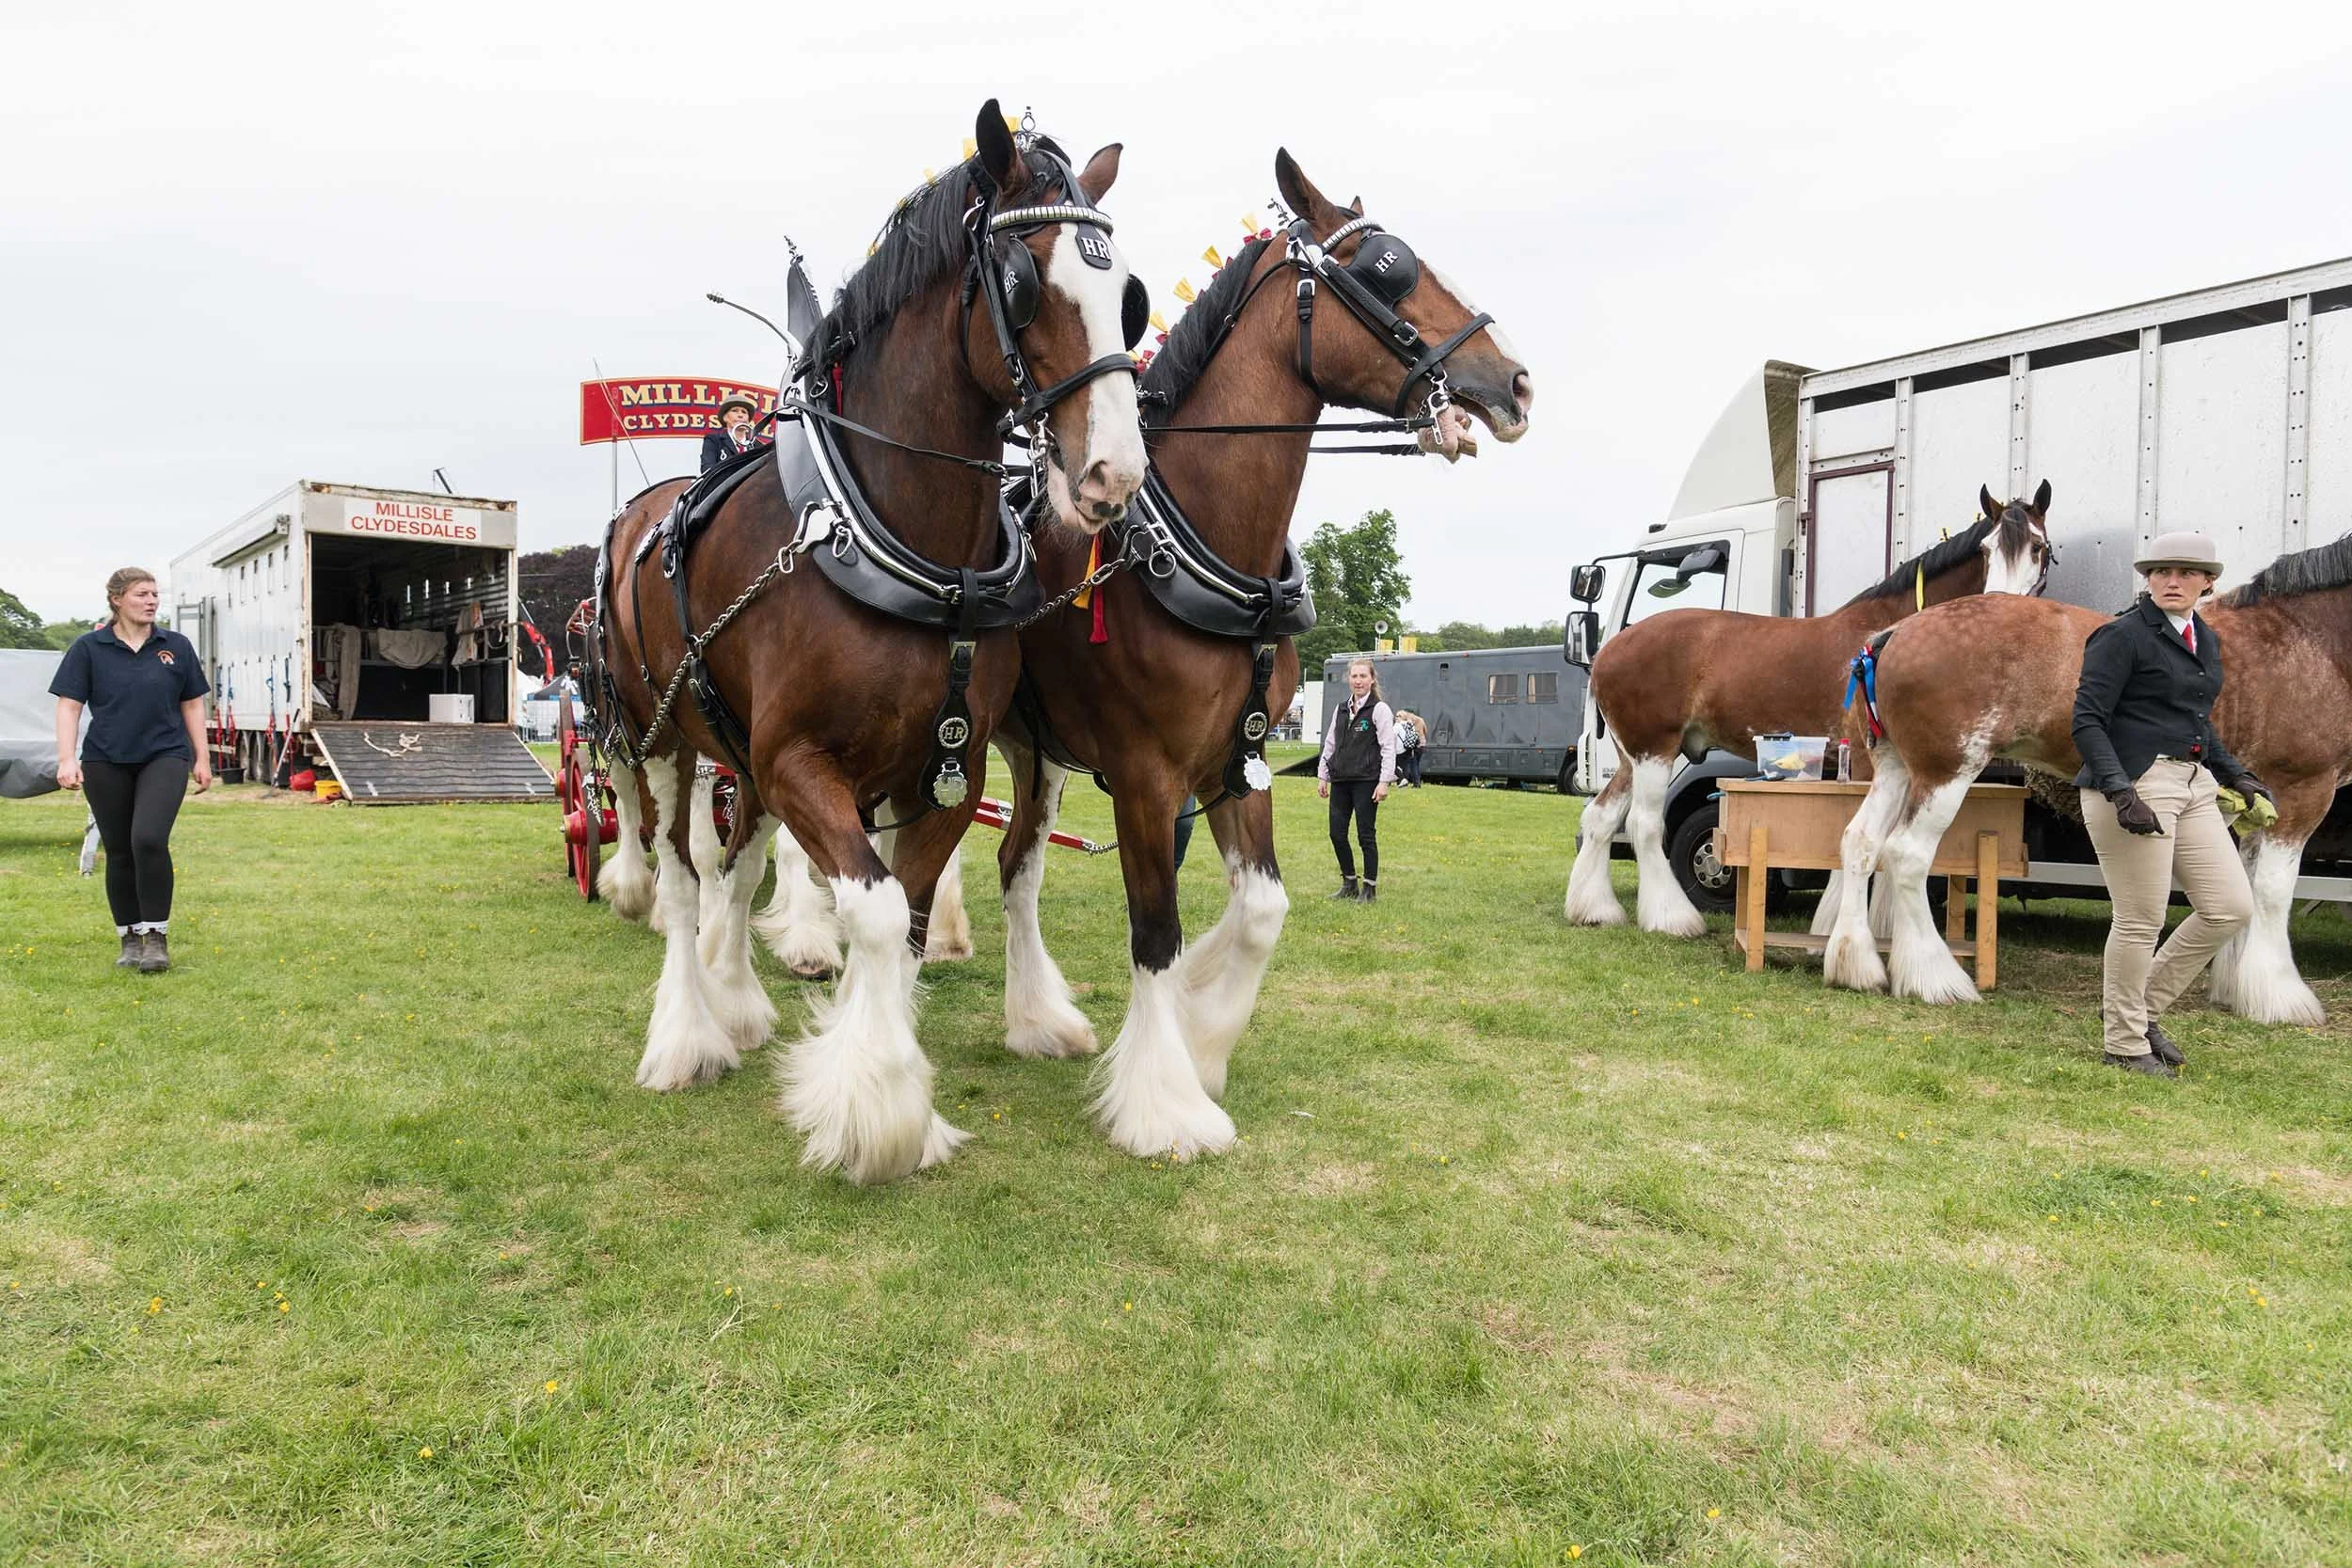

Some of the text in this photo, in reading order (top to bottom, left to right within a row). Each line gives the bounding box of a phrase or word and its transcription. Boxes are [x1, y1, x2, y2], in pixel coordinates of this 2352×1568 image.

[1081, 237, 1111, 260] HR
[1375, 251, 1399, 273] HR
[1004, 271, 1019, 293] HR
[375, 501, 453, 522] MILLISLE
[351, 515, 477, 540] CLYDESDALES
[943, 726, 965, 740] HR
[1249, 721, 1264, 733] HR
